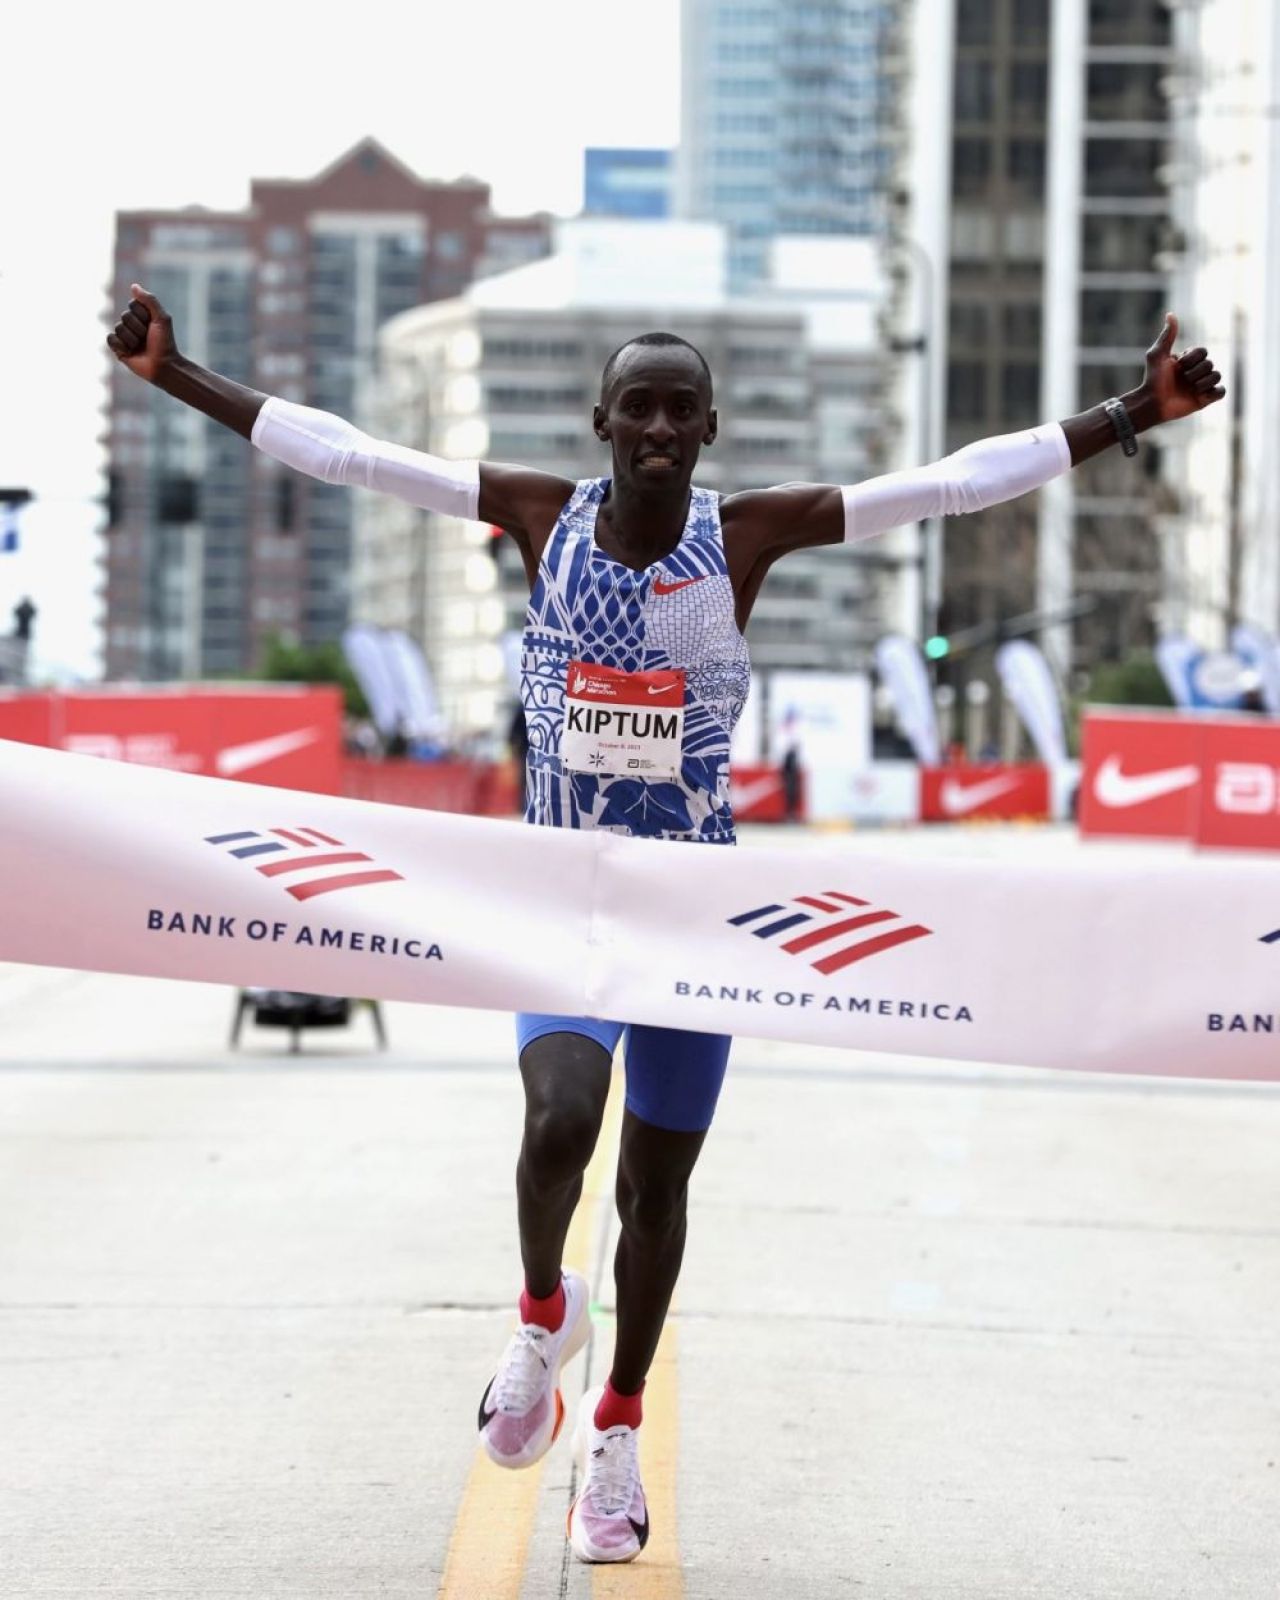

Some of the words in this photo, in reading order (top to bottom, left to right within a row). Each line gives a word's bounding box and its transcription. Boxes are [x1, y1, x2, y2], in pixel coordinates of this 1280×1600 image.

[567, 705, 678, 739] KIPTUM
[147, 909, 236, 938] BANK
[246, 919, 288, 942] OF
[295, 926, 444, 961] AMERICA
[674, 981, 763, 1004] BANK
[773, 991, 815, 1008] OF
[823, 995, 974, 1023] AMERICA
[1207, 1013, 1280, 1034] BAN
